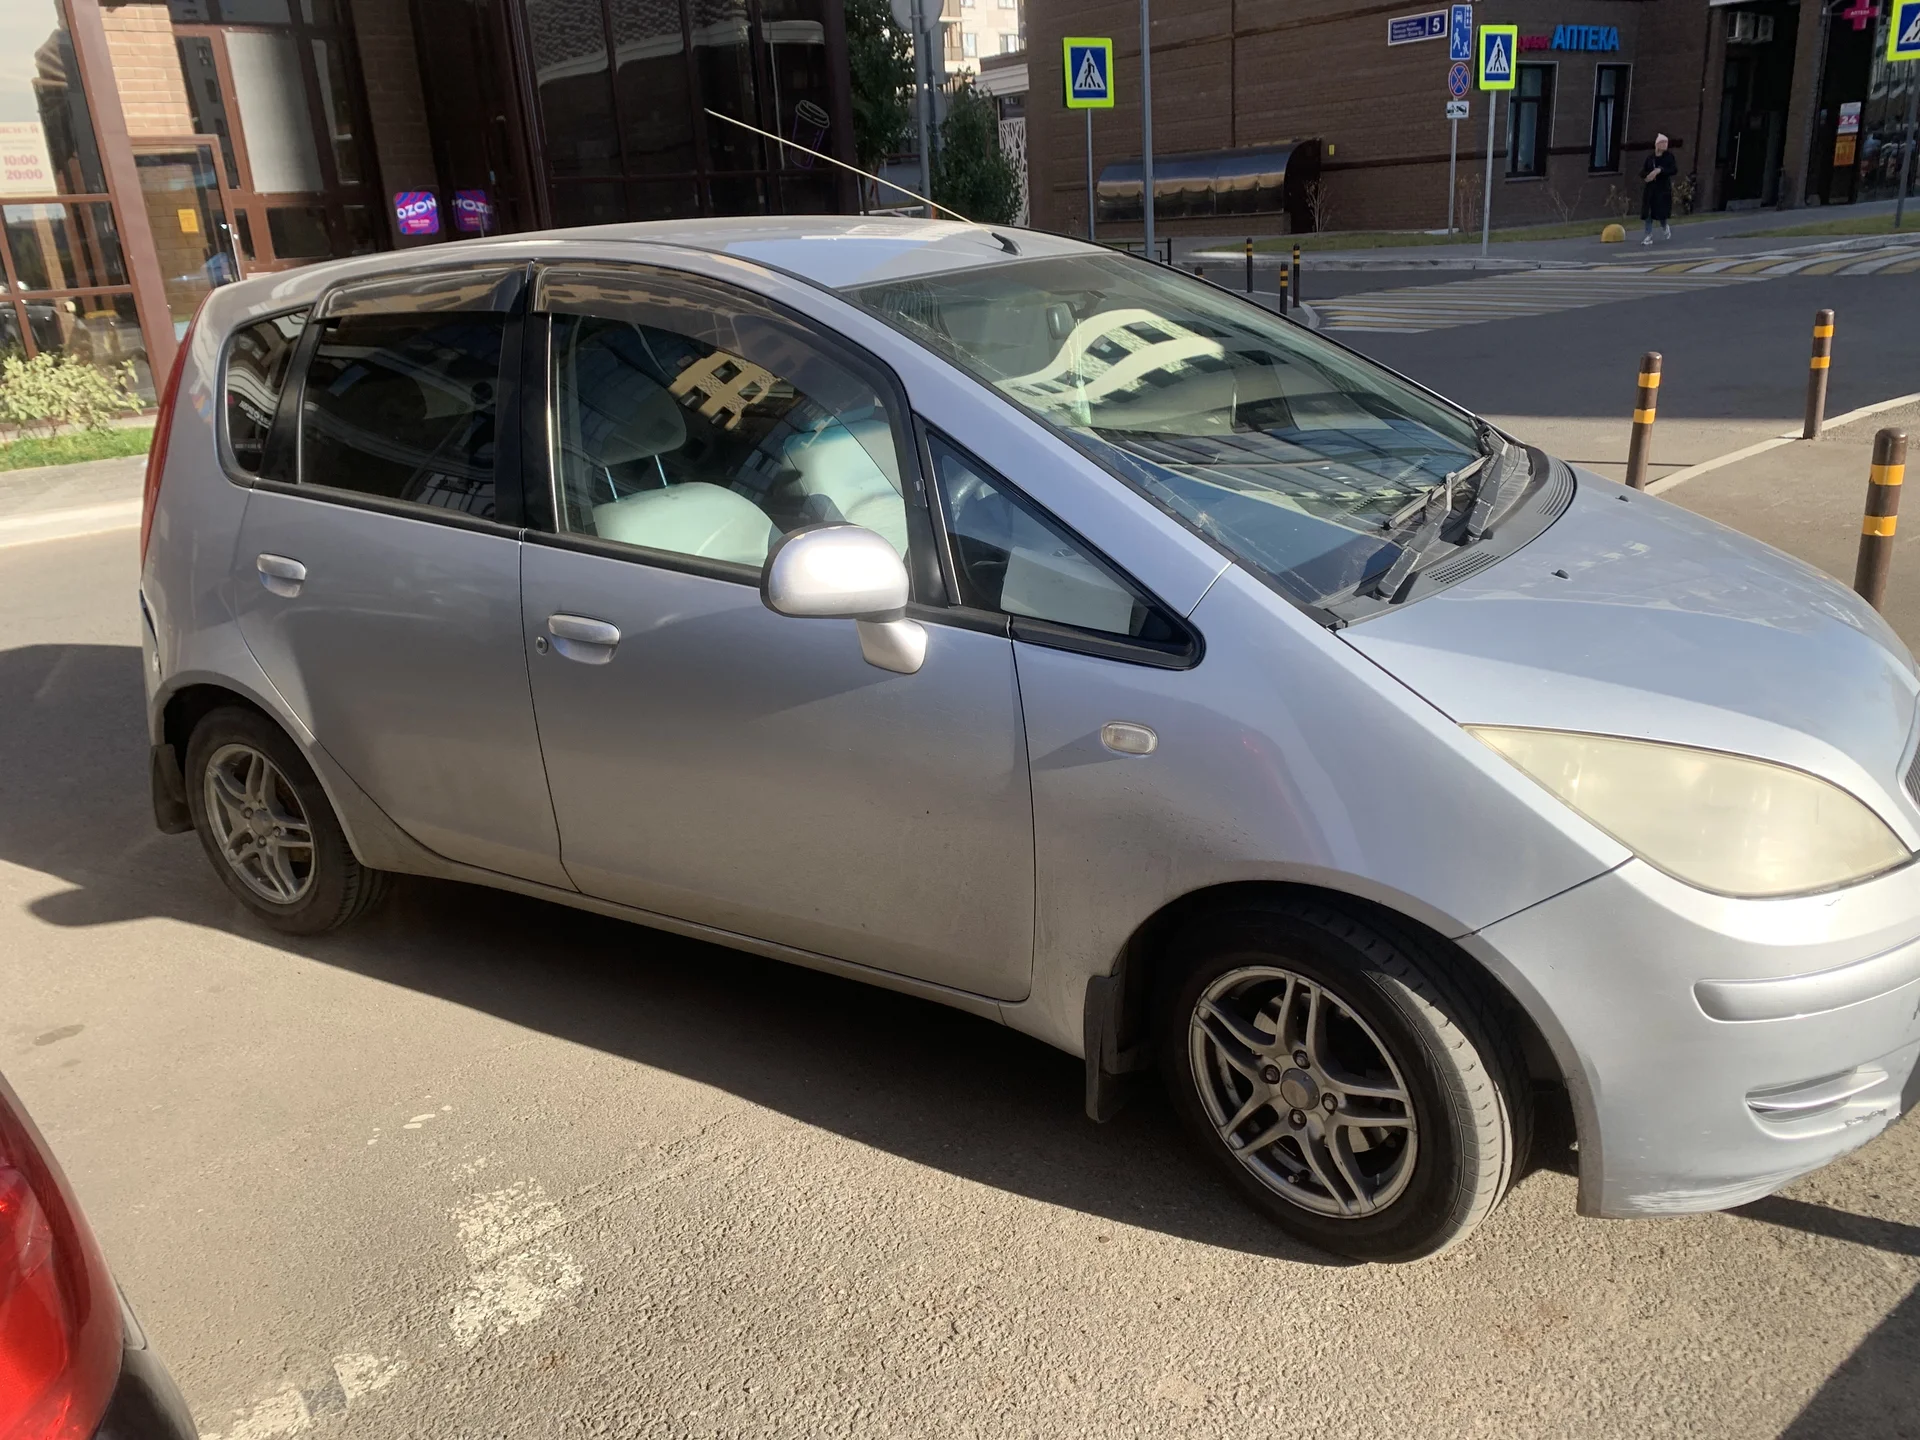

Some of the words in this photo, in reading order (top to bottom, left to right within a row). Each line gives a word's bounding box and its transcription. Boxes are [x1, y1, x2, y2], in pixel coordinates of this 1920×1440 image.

[1432, 17, 1440, 32] 5
[1552, 25, 1619, 50] АПТЕКА
[1841, 114, 1857, 125] 24
[4, 155, 38, 166] 10:00
[5, 169, 43, 180] 20:00
[396, 198, 437, 219] OZON
